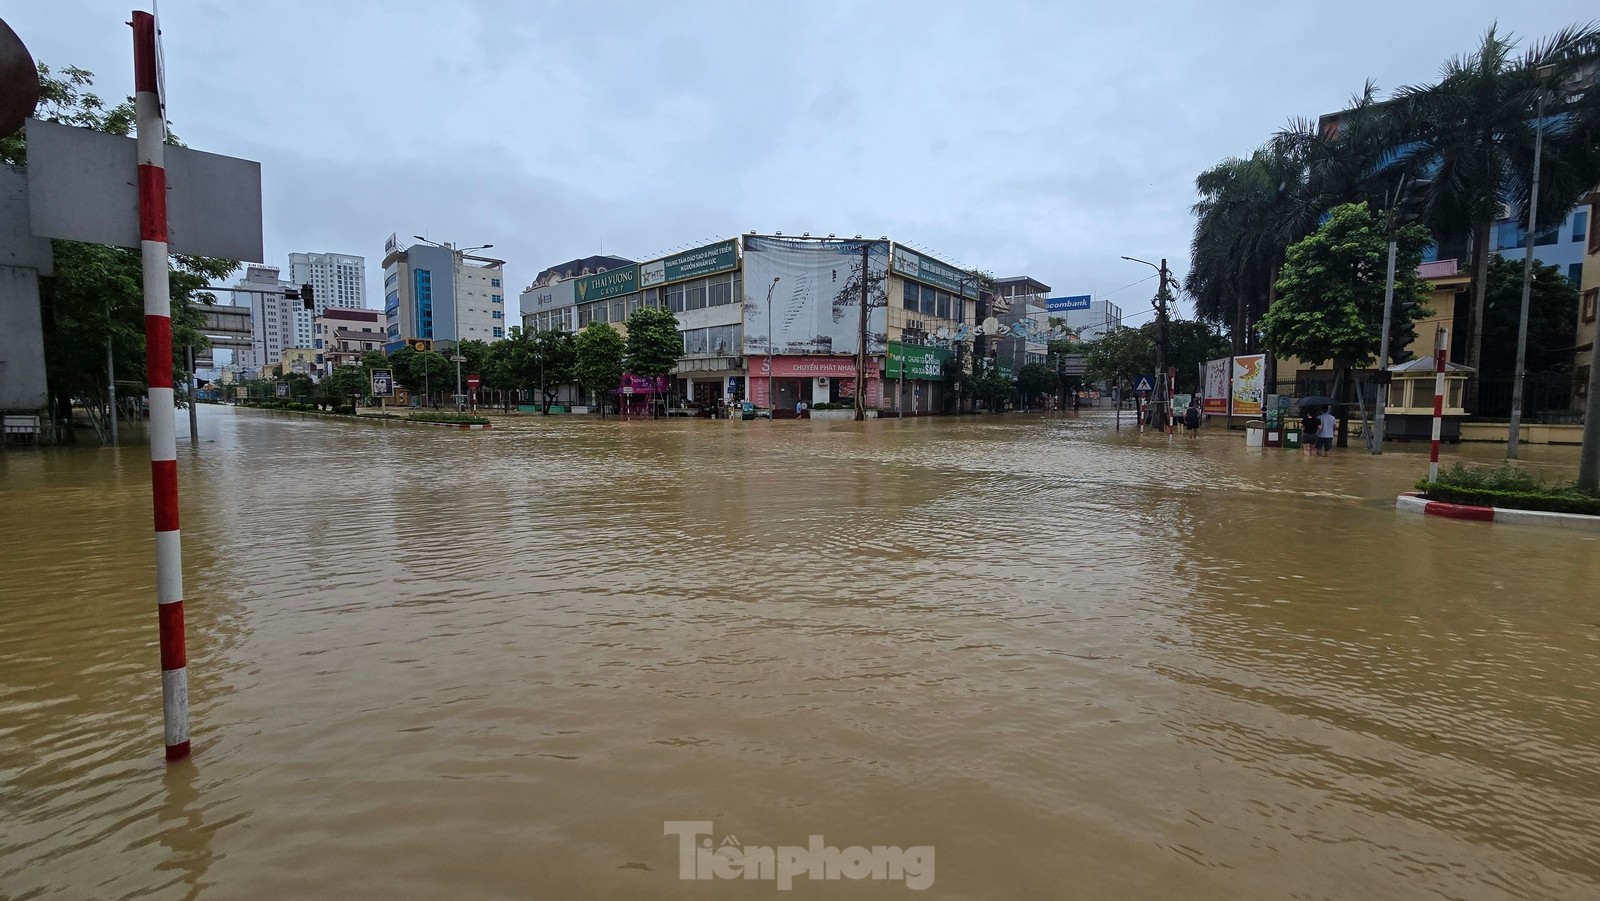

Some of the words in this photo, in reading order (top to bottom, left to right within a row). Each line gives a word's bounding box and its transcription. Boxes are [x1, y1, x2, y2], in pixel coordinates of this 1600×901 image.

[651, 269, 664, 278] HTC
[591, 276, 607, 290] THÁI
[600, 285, 624, 296] GROUP
[793, 362, 818, 371] CHUYỂN
